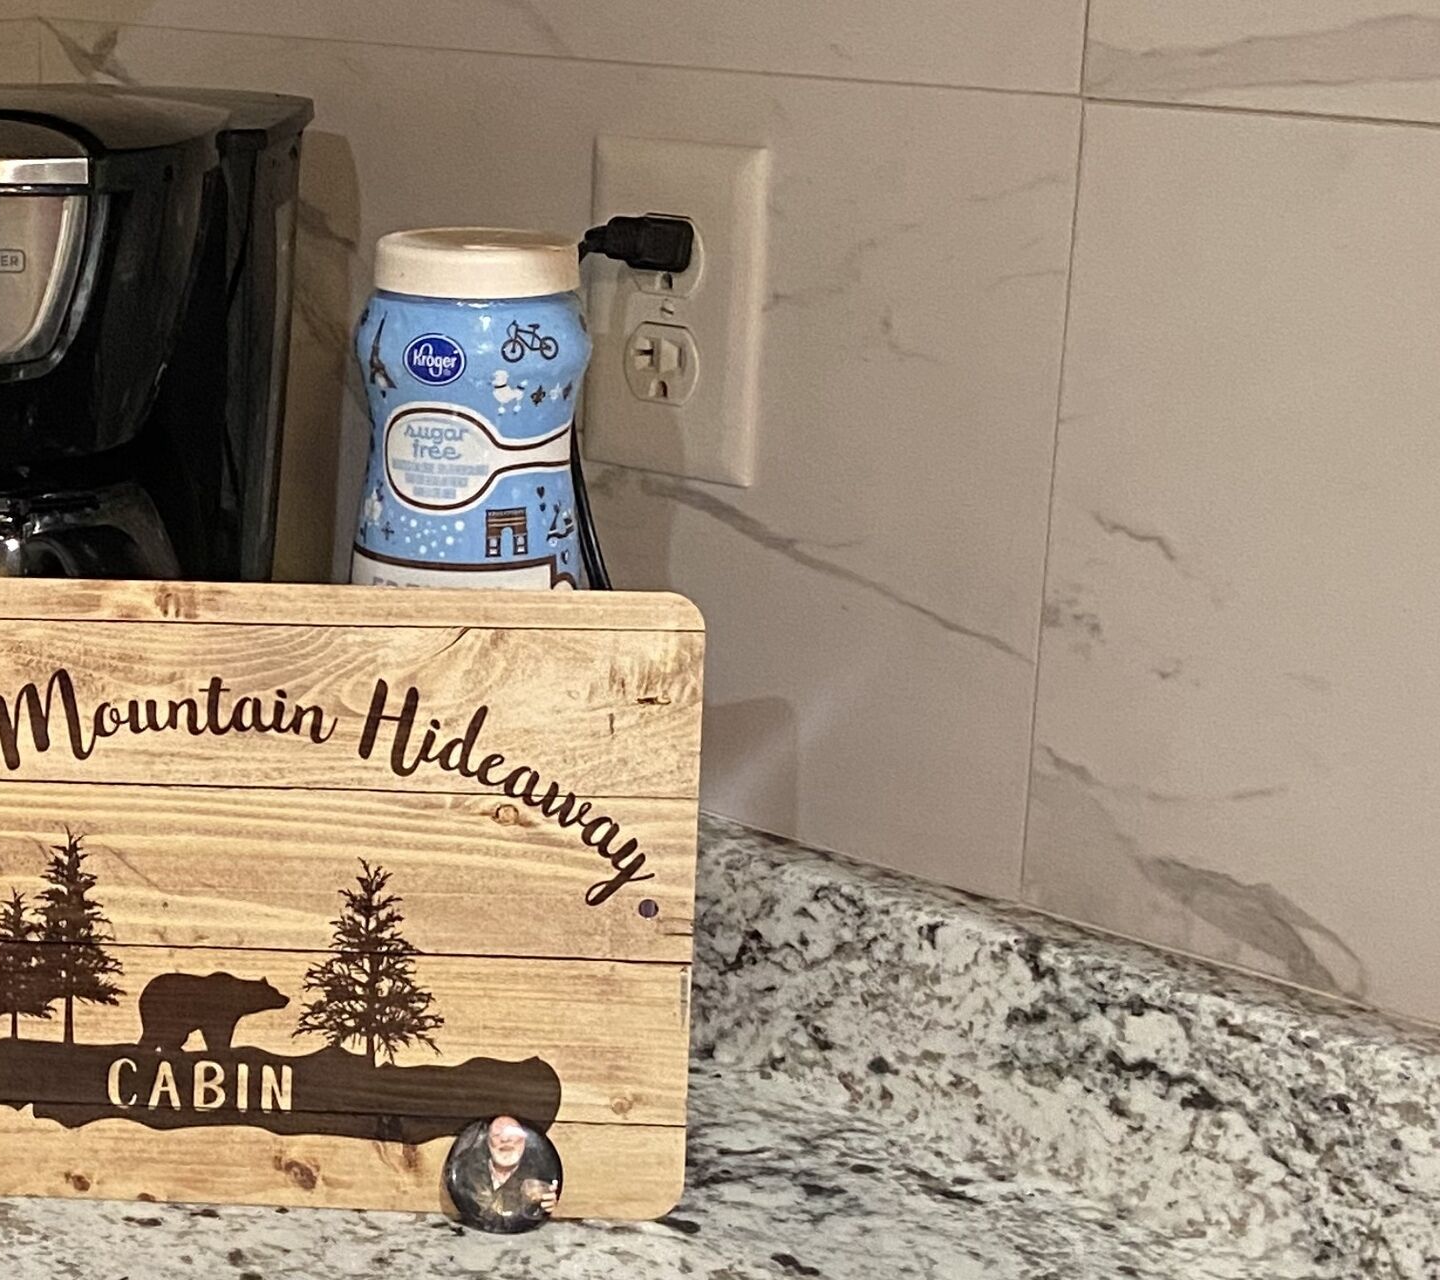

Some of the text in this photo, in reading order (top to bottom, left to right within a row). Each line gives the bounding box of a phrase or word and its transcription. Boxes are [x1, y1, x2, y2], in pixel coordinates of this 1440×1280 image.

[413, 342, 458, 377] Kroger
[404, 423, 469, 445] sugar
[412, 438, 462, 460] free
[358, 678, 655, 907] Hideaway
[107, 1057, 294, 1114] CABIN
